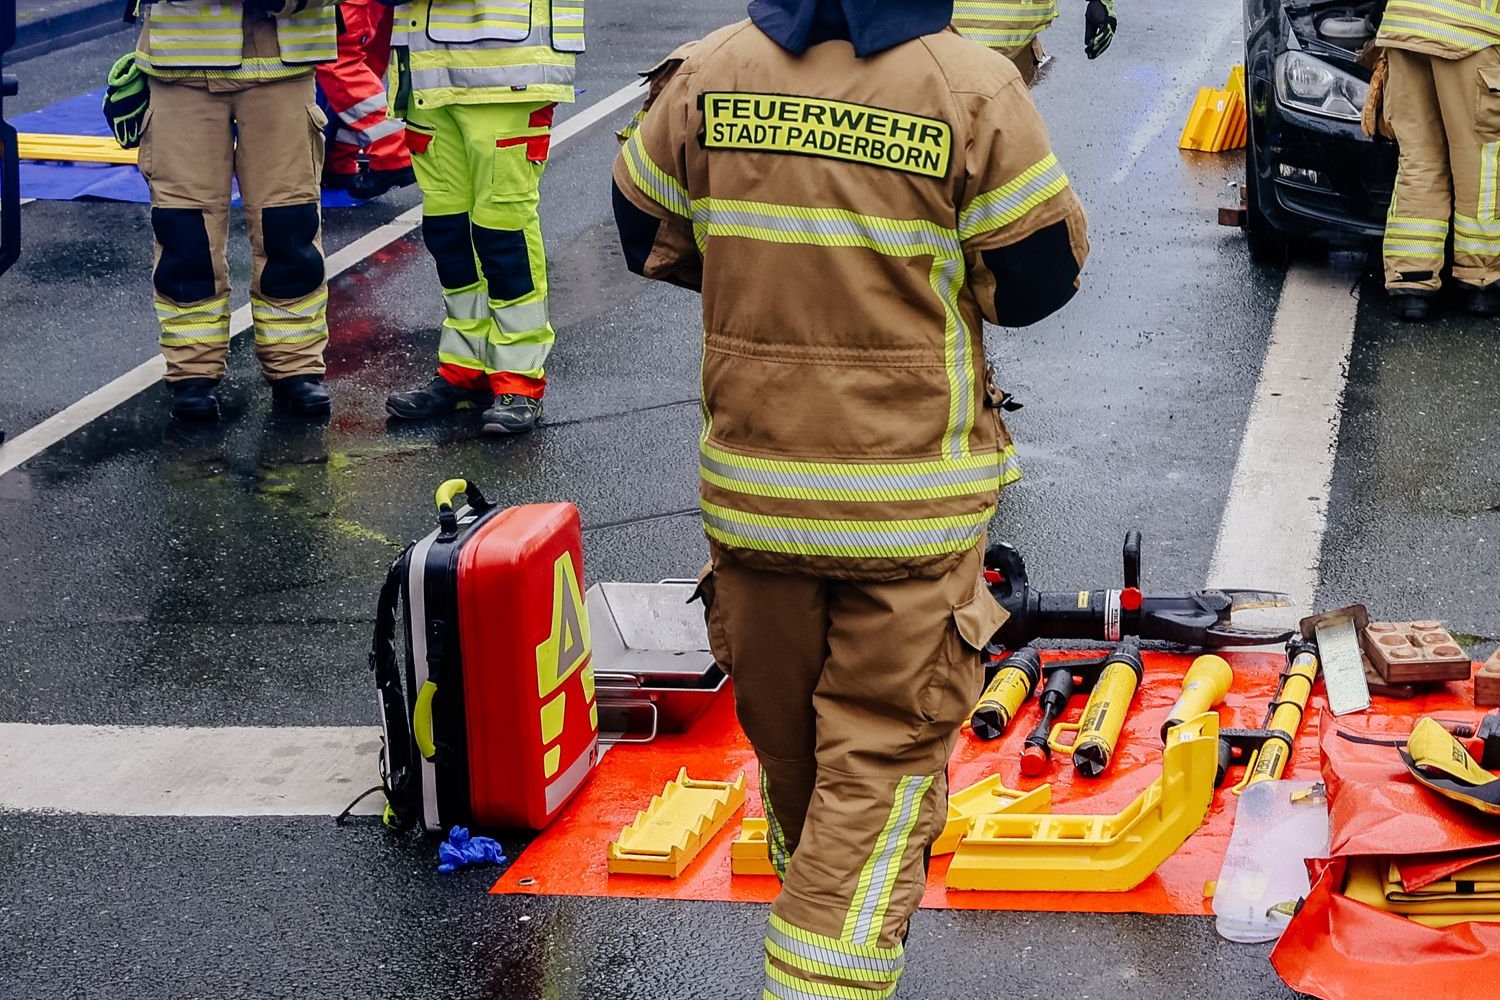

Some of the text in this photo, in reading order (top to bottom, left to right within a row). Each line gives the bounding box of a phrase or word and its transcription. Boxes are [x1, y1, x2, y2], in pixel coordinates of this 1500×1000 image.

[712, 98, 944, 147] FEUERWEHR
[712, 122, 941, 171] STADT PADERBORN
